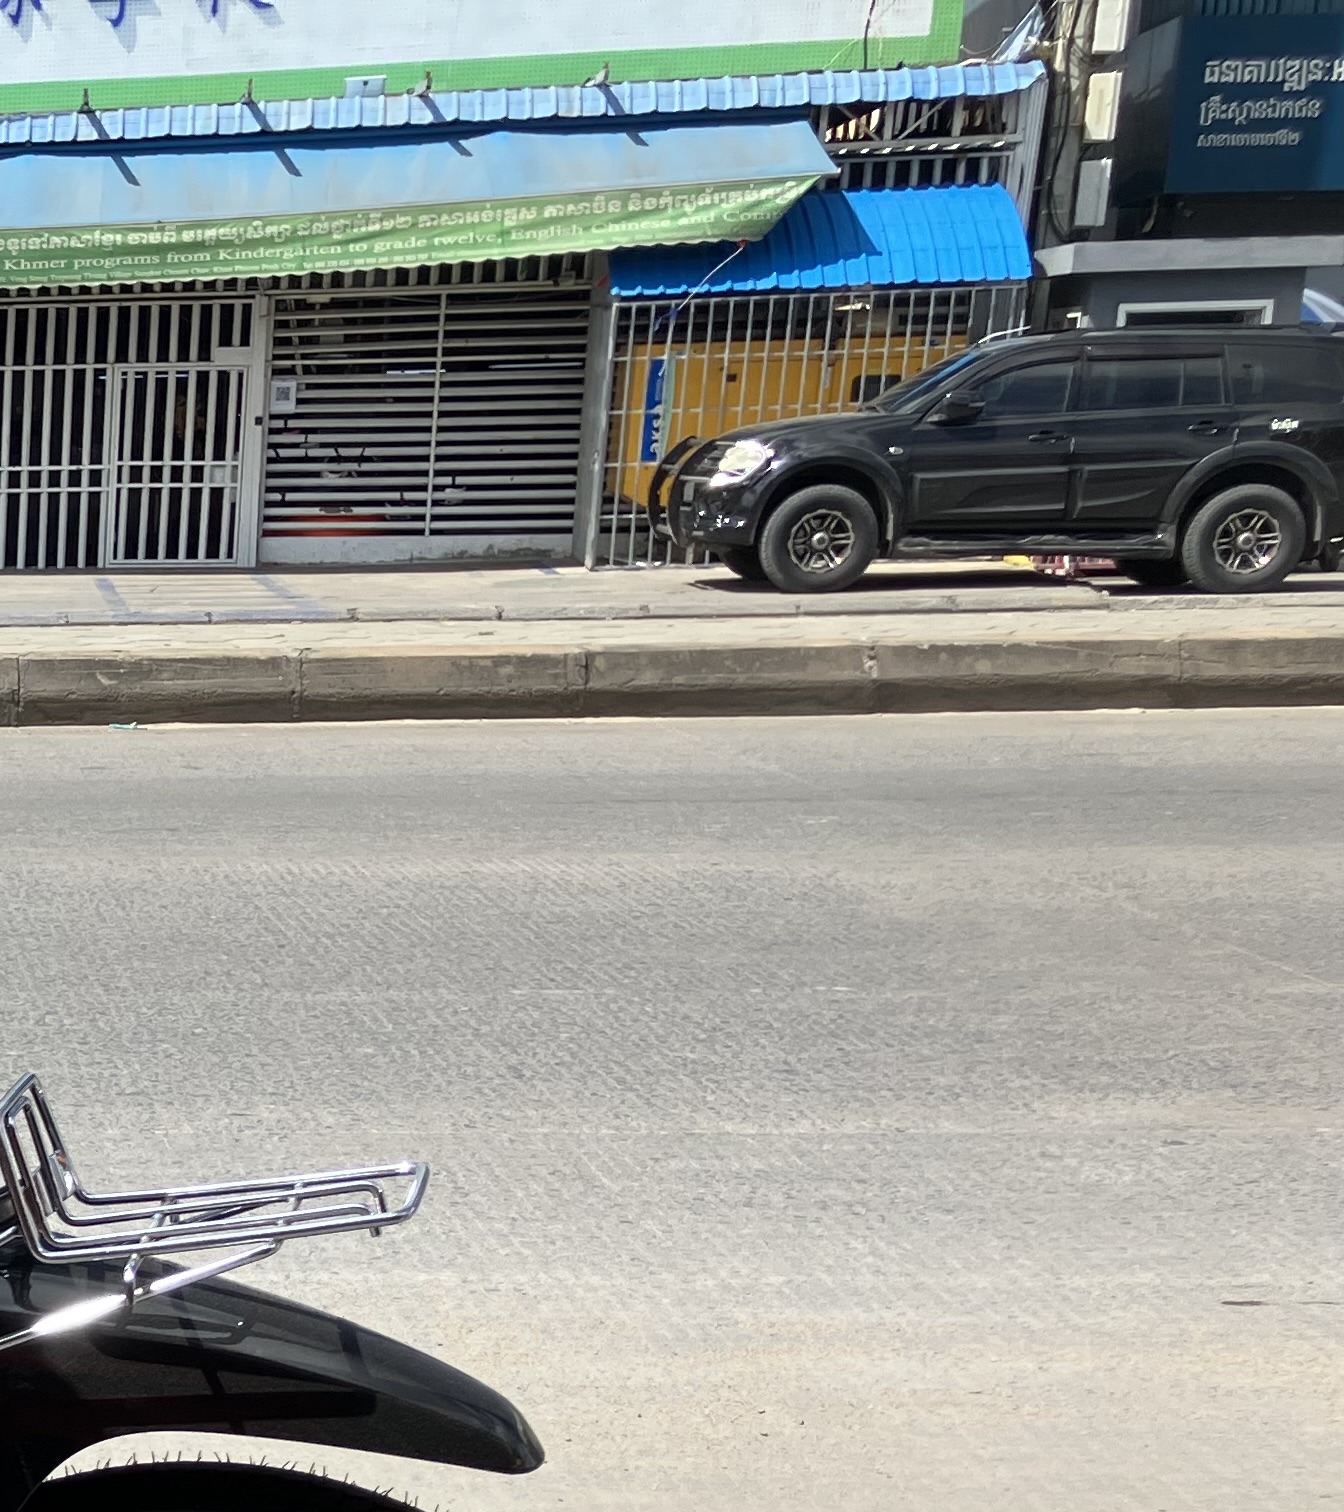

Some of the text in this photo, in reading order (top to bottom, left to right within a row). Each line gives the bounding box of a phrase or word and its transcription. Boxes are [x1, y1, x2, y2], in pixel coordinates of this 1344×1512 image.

[3, 258, 68, 271] Khmer
[73, 254, 160, 270] programs
[166, 251, 210, 263] from
[219, 244, 341, 260] Kindergarten
[349, 241, 367, 252] to
[373, 237, 427, 254] grade
[511, 224, 583, 242] English
[677, 212, 712, 227] and
